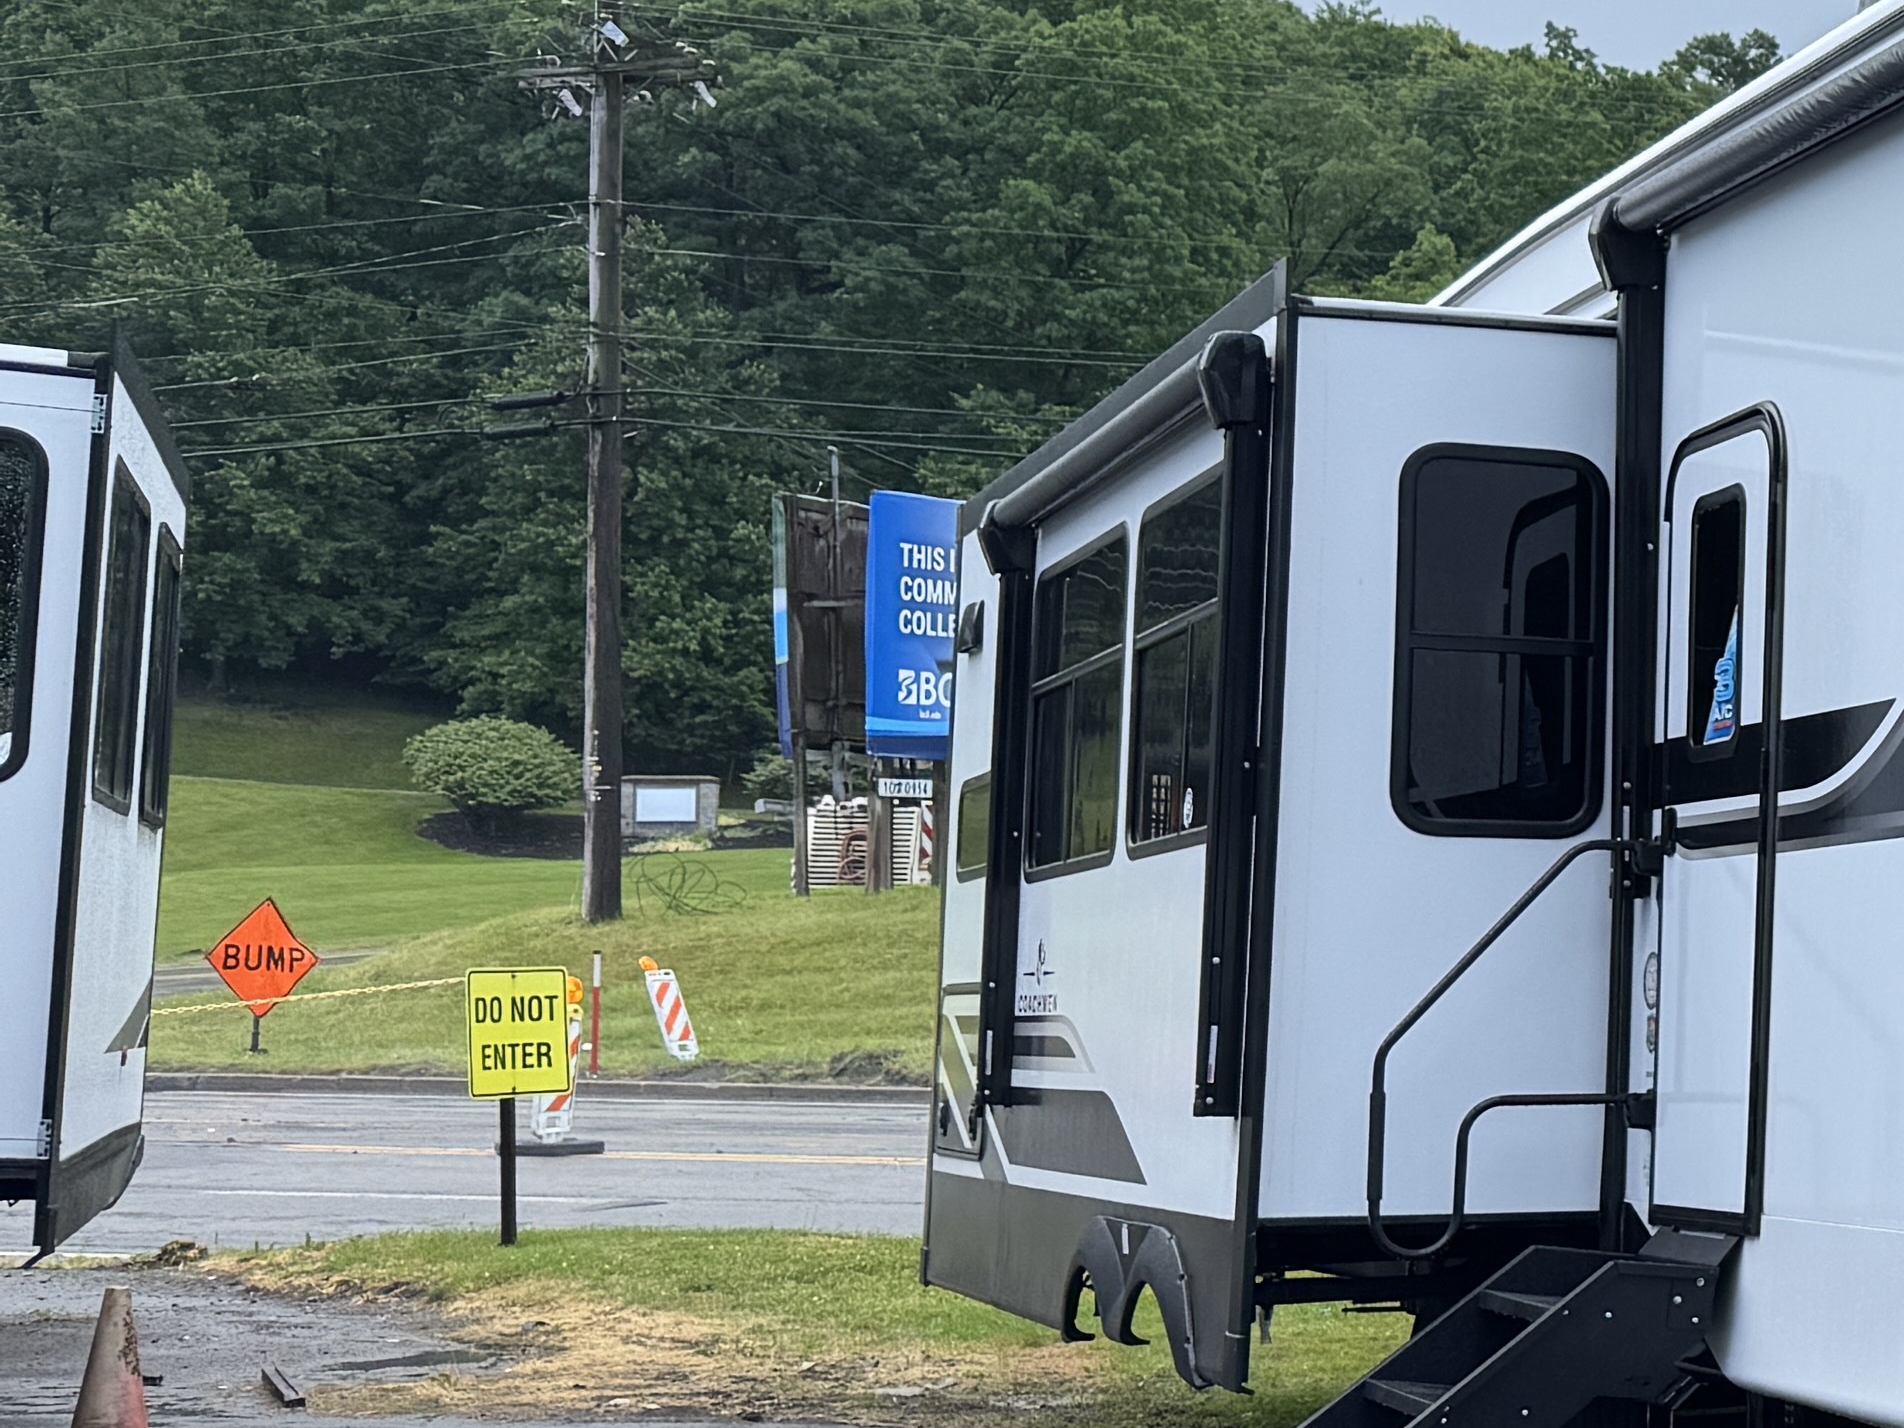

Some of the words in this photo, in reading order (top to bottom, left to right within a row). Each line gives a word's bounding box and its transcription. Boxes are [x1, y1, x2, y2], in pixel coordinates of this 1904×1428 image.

[899, 542, 945, 572] THIS
[222, 943, 305, 973] BUMP
[475, 996, 502, 1024] DO
[511, 995, 559, 1023] NOT
[481, 1042, 552, 1071] ENTER
